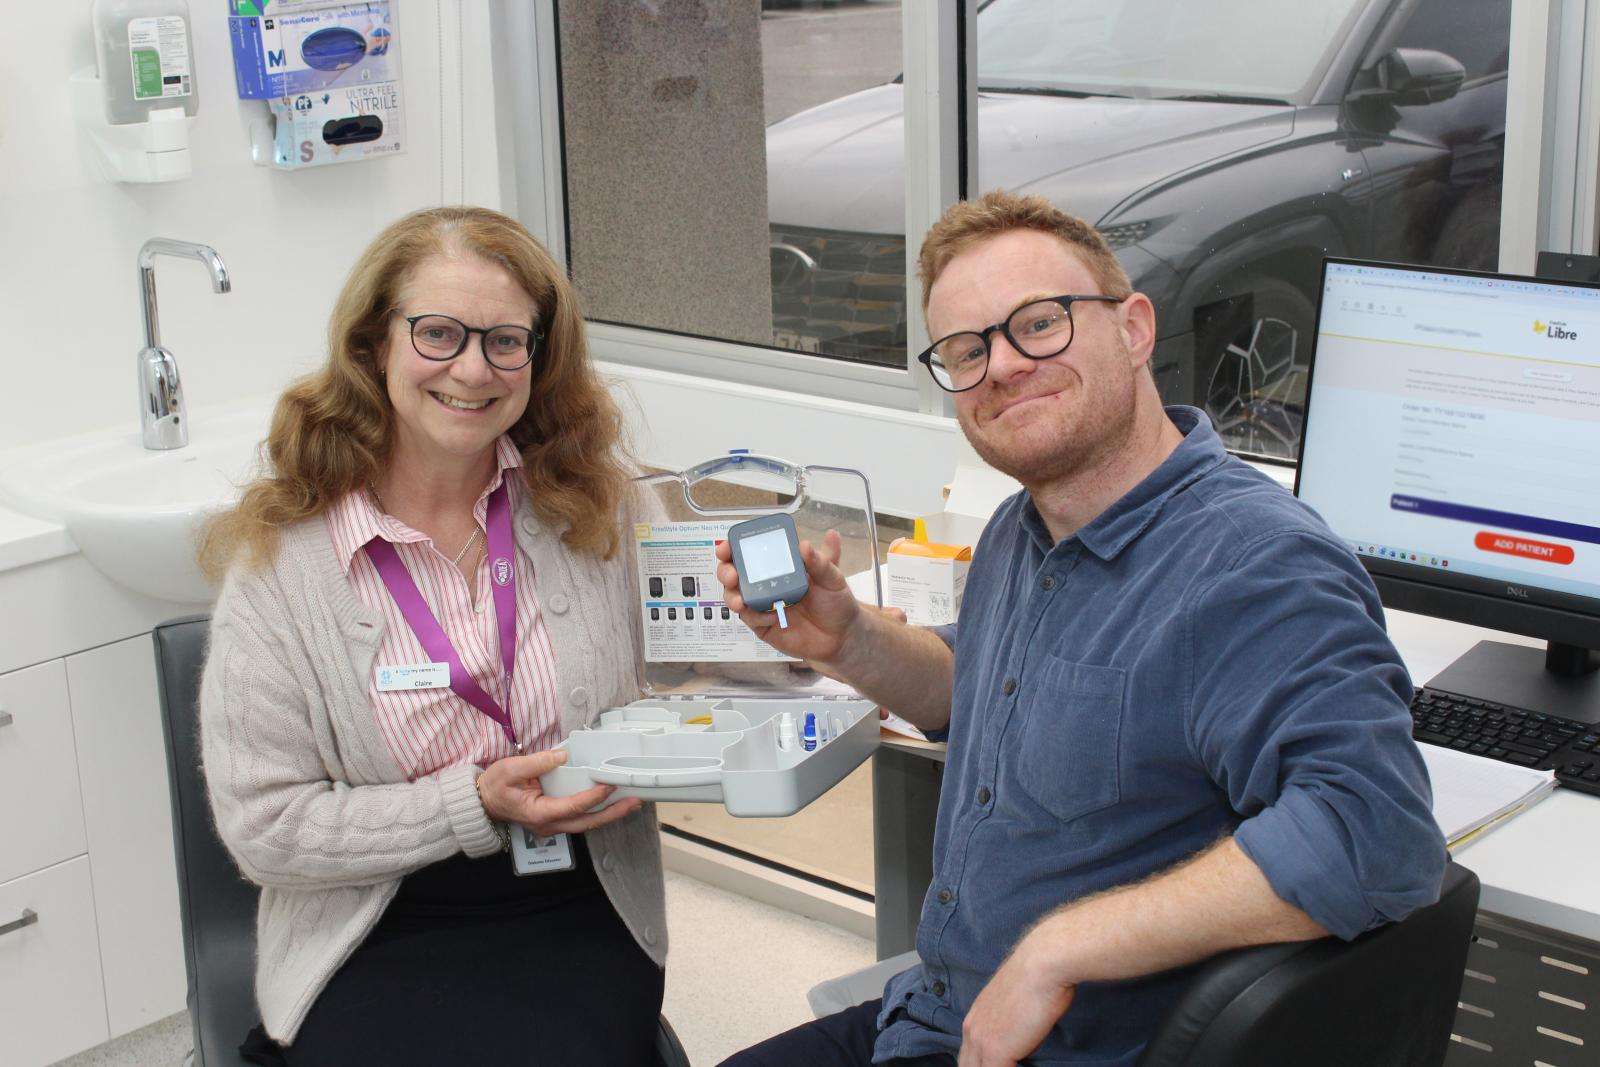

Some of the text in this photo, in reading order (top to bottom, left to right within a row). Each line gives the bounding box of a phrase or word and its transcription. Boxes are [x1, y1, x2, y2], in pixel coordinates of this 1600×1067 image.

[268, 49, 287, 68] M
[350, 94, 398, 113] NITRILE
[300, 141, 315, 163] S
[1547, 326, 1578, 340] Libre
[1494, 539, 1555, 557] ADD PATIENT
[1506, 586, 1529, 598] DELL
